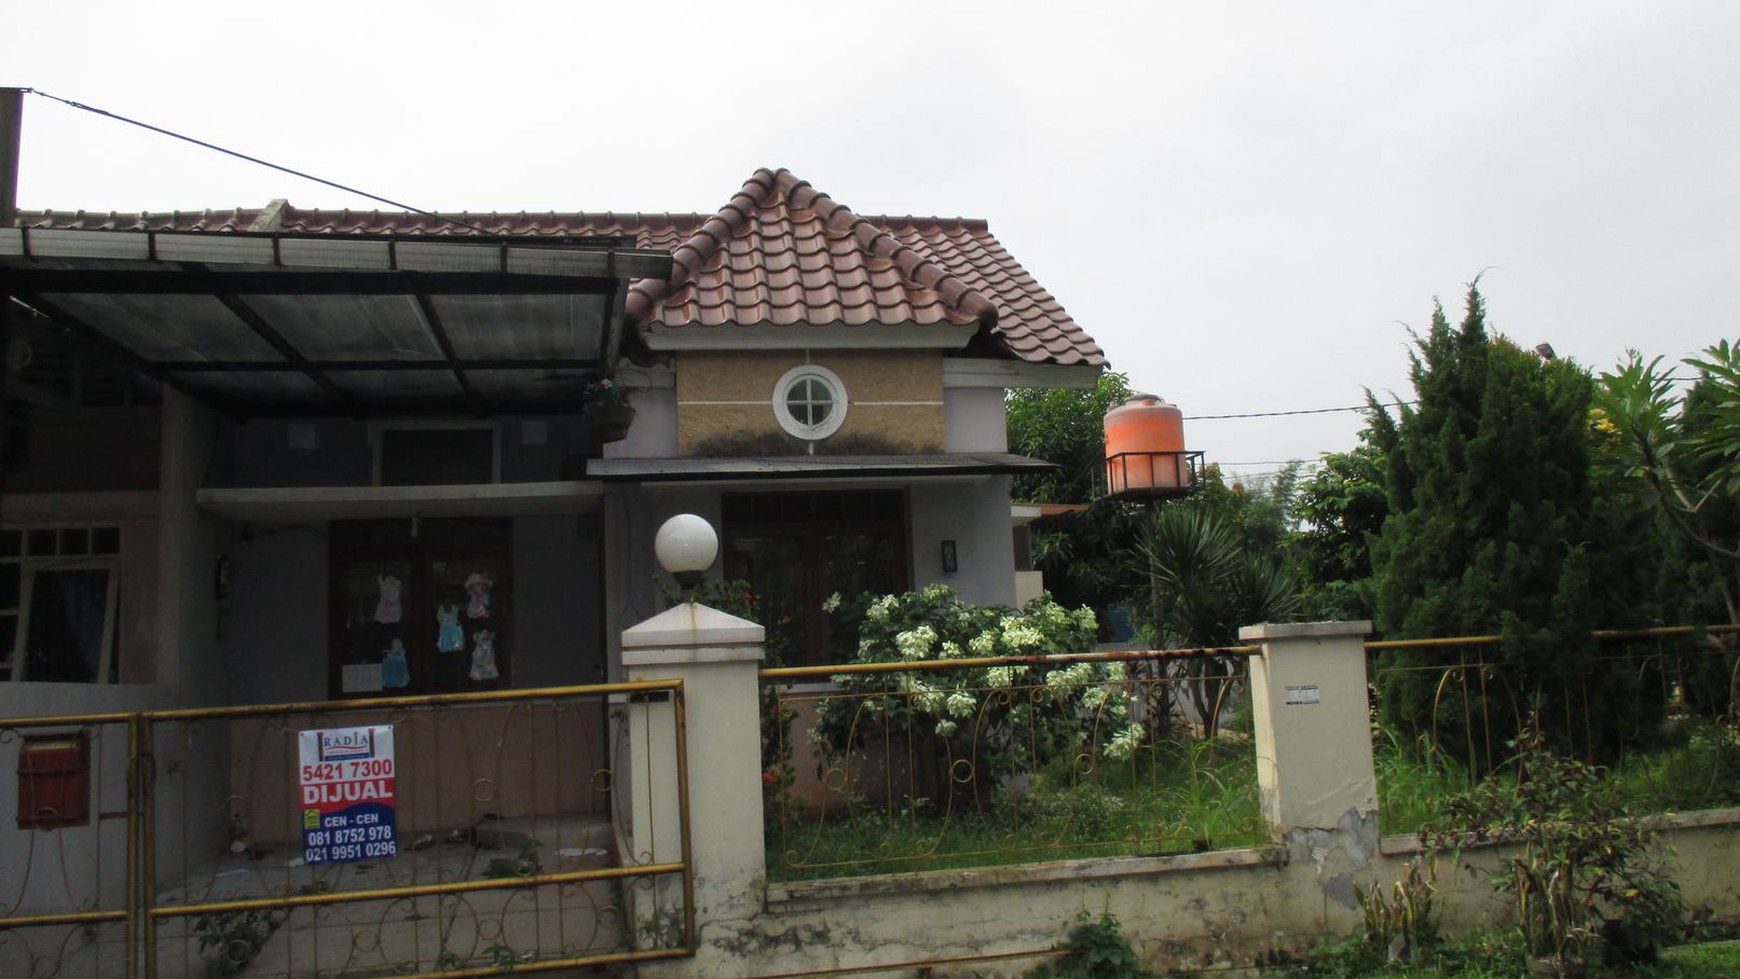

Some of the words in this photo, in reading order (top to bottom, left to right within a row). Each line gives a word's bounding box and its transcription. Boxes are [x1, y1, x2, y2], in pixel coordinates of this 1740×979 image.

[303, 764, 342, 781] 5421
[351, 759, 392, 777] 7300
[304, 780, 393, 804] DIJUAL
[324, 816, 347, 827] CEN
[356, 813, 379, 824] CEN
[308, 831, 330, 846] 081
[335, 828, 365, 843] 8752
[368, 825, 391, 840] 978
[306, 847, 327, 861] 021
[332, 844, 361, 859] 9951
[366, 841, 396, 856] 0296
